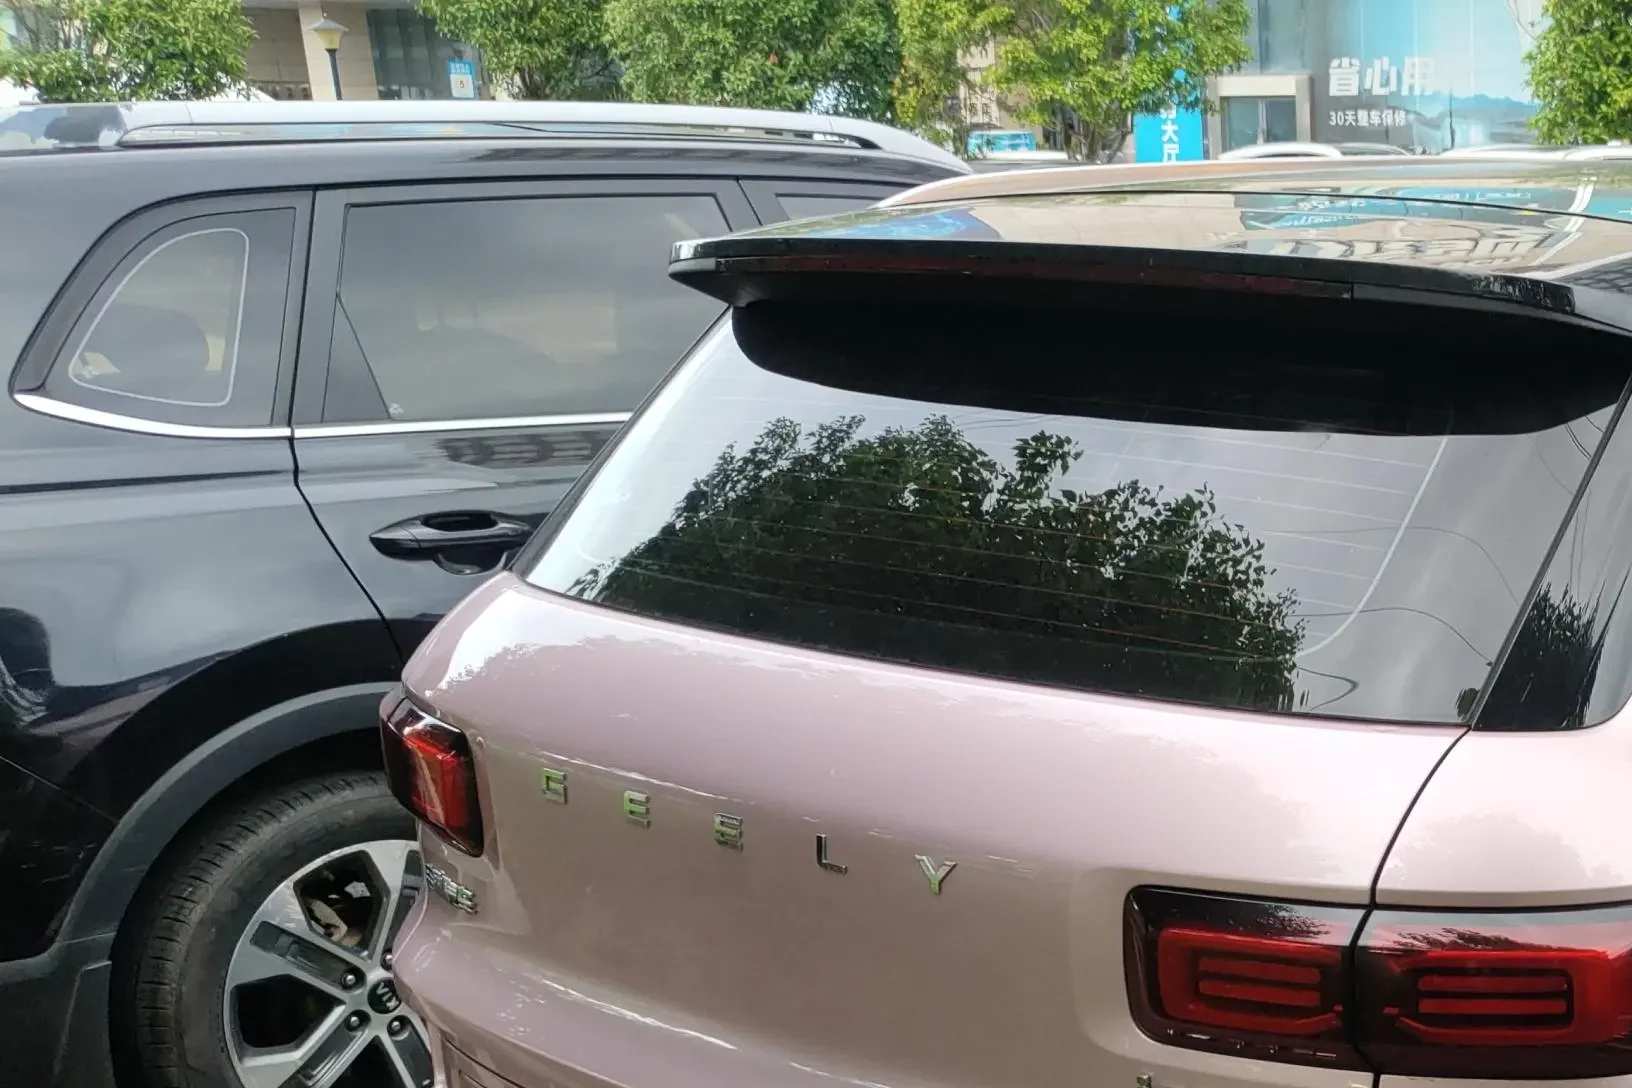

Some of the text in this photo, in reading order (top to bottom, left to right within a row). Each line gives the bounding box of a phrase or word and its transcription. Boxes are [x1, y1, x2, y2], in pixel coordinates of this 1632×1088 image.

[1328, 109, 1407, 128] 30天整车保修
[540, 766, 958, 897] GEELY
